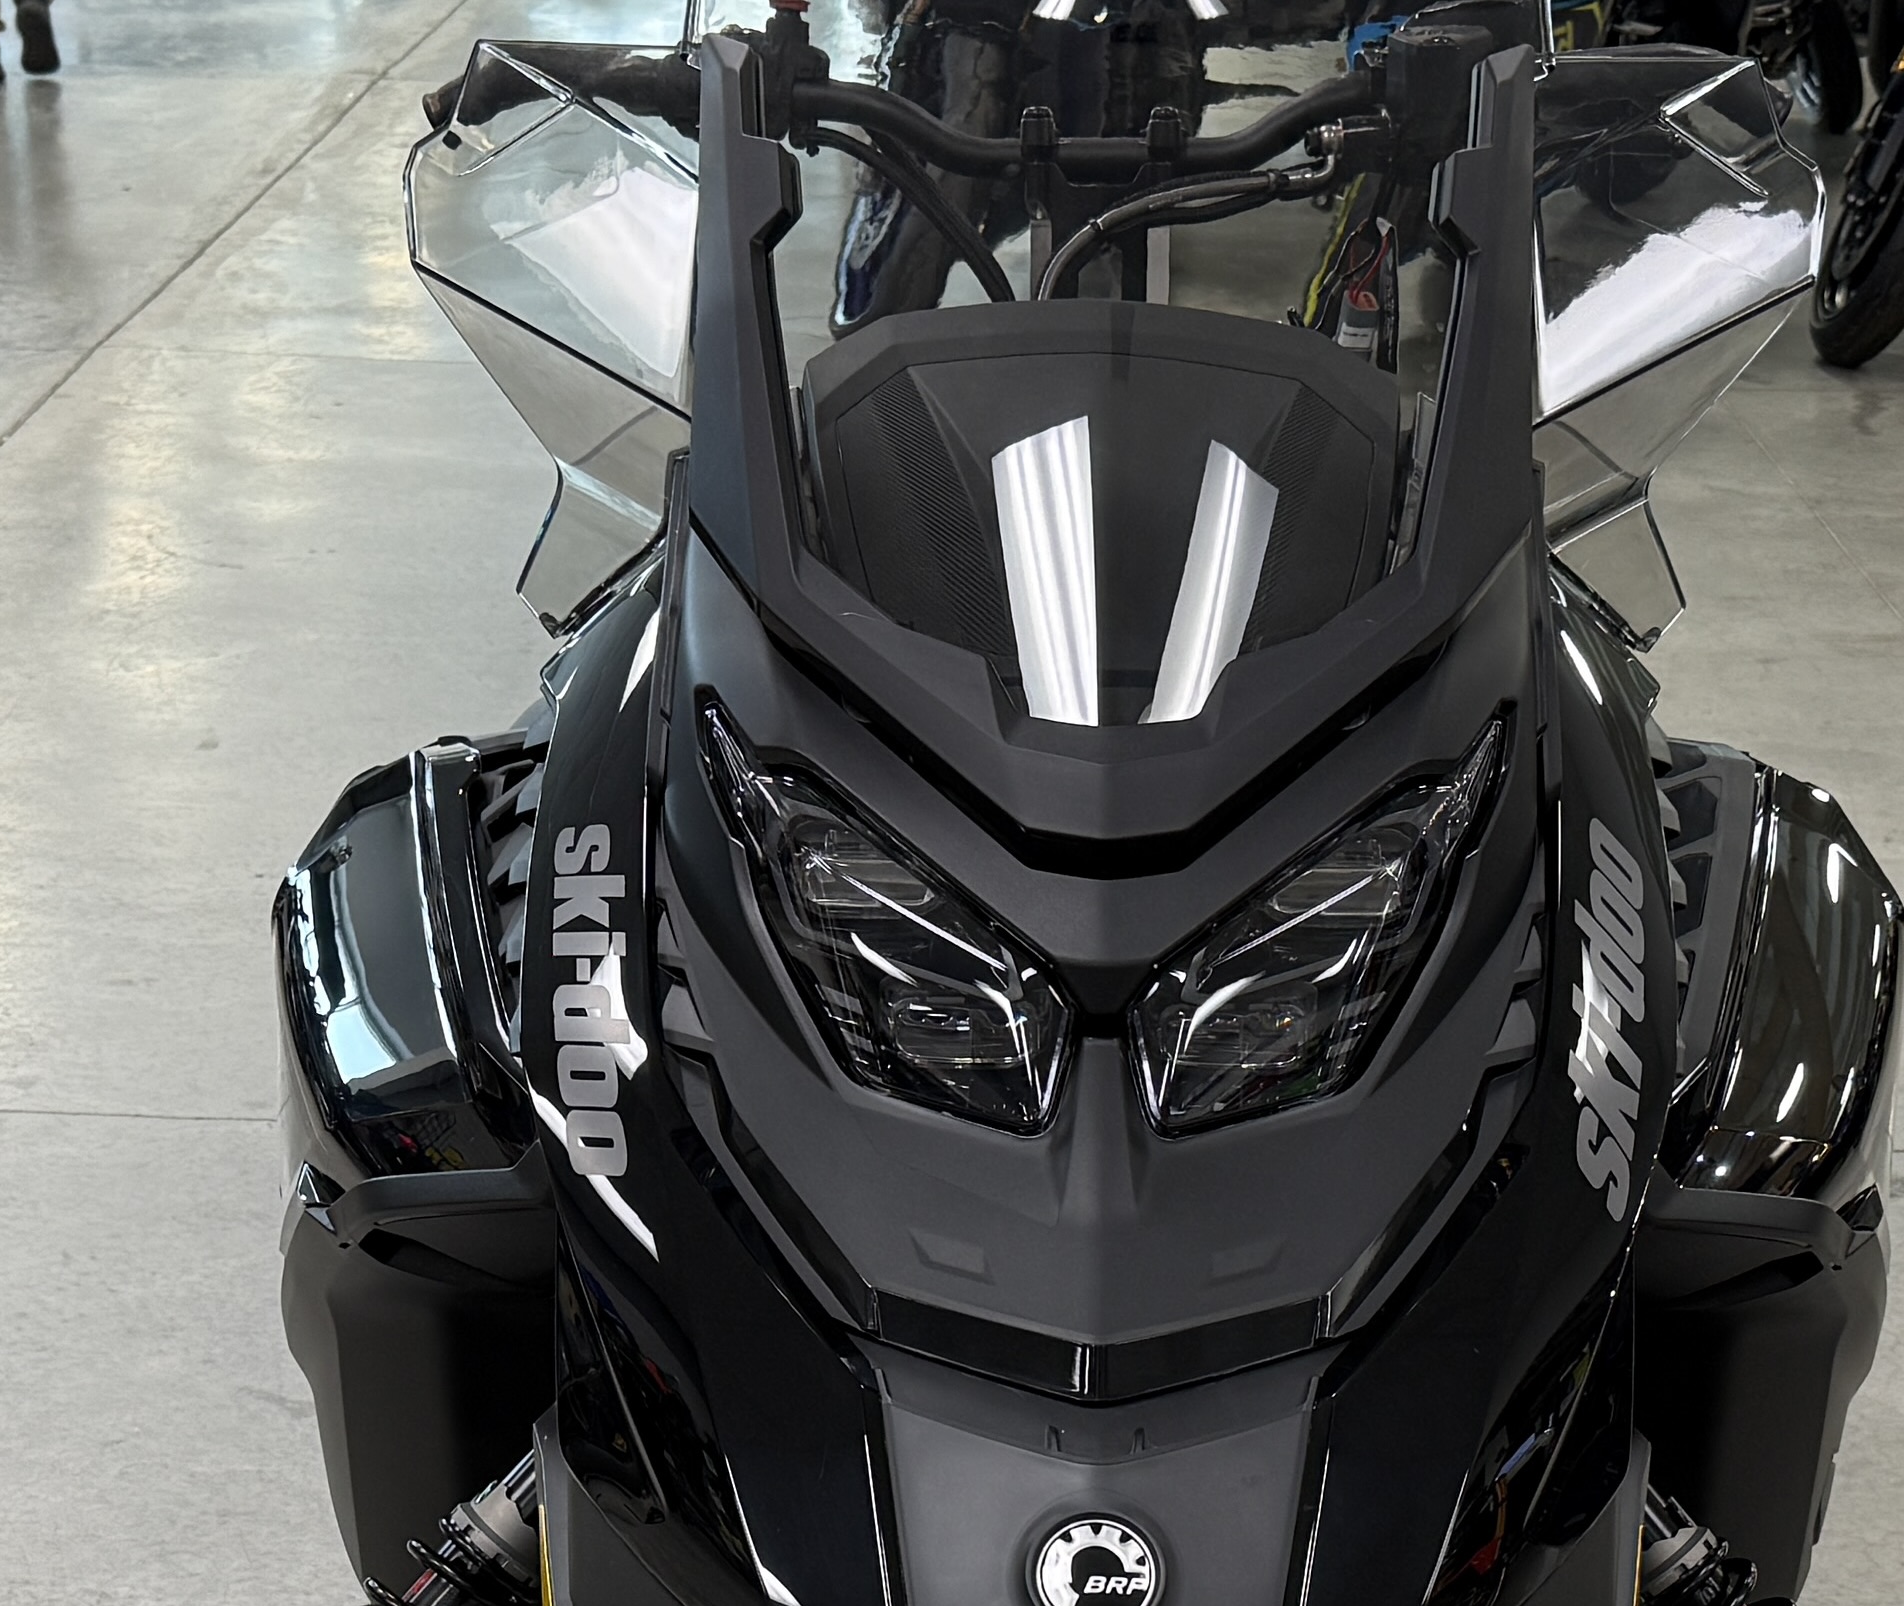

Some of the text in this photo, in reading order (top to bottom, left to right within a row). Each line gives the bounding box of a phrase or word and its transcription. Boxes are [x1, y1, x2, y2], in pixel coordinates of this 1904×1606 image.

[552, 823, 630, 1177] ski-doo
[1568, 817, 1645, 1222] ski-doo
[1083, 1575, 1149, 1595] BRP
